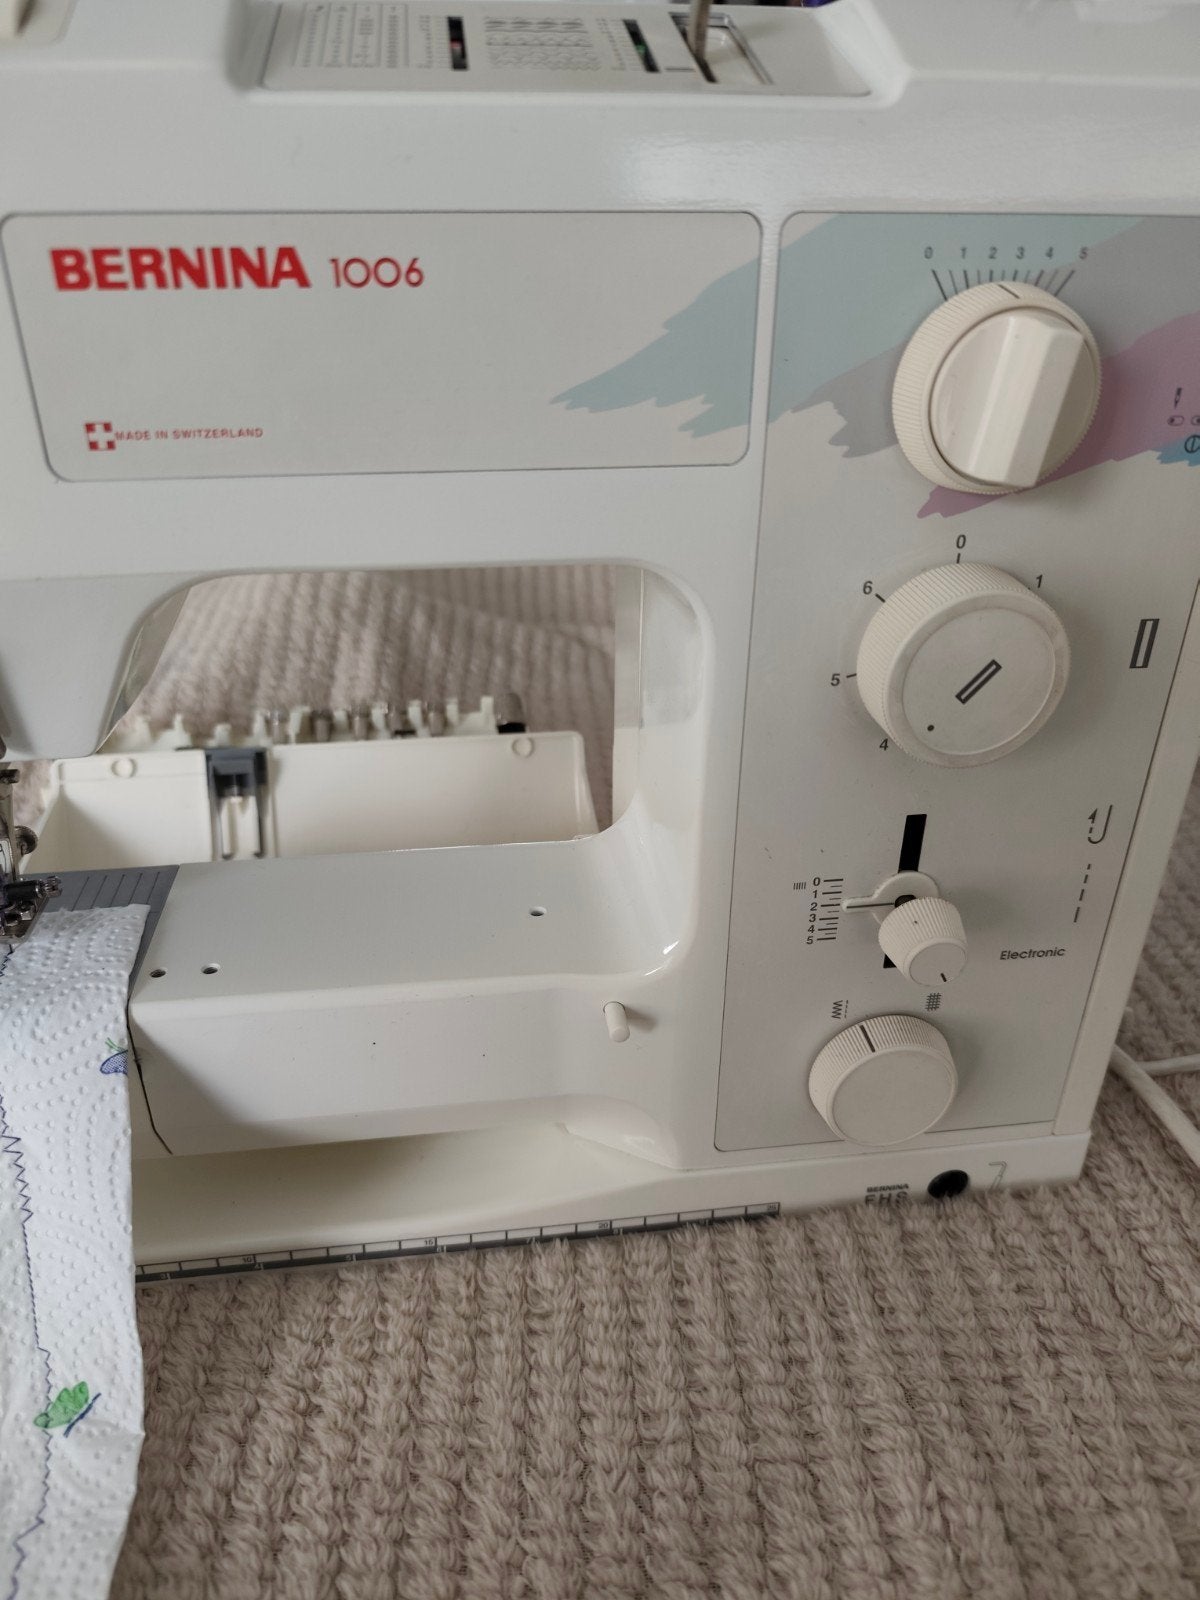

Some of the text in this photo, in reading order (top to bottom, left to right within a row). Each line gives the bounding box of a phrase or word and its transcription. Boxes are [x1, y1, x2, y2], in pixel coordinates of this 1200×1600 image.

[924, 246, 934, 260] 0
[960, 246, 967, 259] 1
[988, 246, 998, 260] 2
[1016, 246, 1025, 260] 3
[50, 246, 424, 291] BERNINA 1006
[115, 427, 264, 441] MADE IN SWITZERLAND
[956, 534, 967, 549] 0
[862, 580, 873, 596] 6
[1035, 574, 1043, 589] 1
[830, 673, 841, 687] 5
[879, 738, 889, 751] 4
[813, 876, 820, 886] 0
[812, 889, 818, 899] 1
[810, 902, 818, 911] 2
[809, 913, 816, 922] 3
[807, 924, 815, 933] 4
[806, 935, 814, 945] 5
[1000, 946, 1066, 960] Electronic
[867, 1183, 909, 1193] BERNINA
